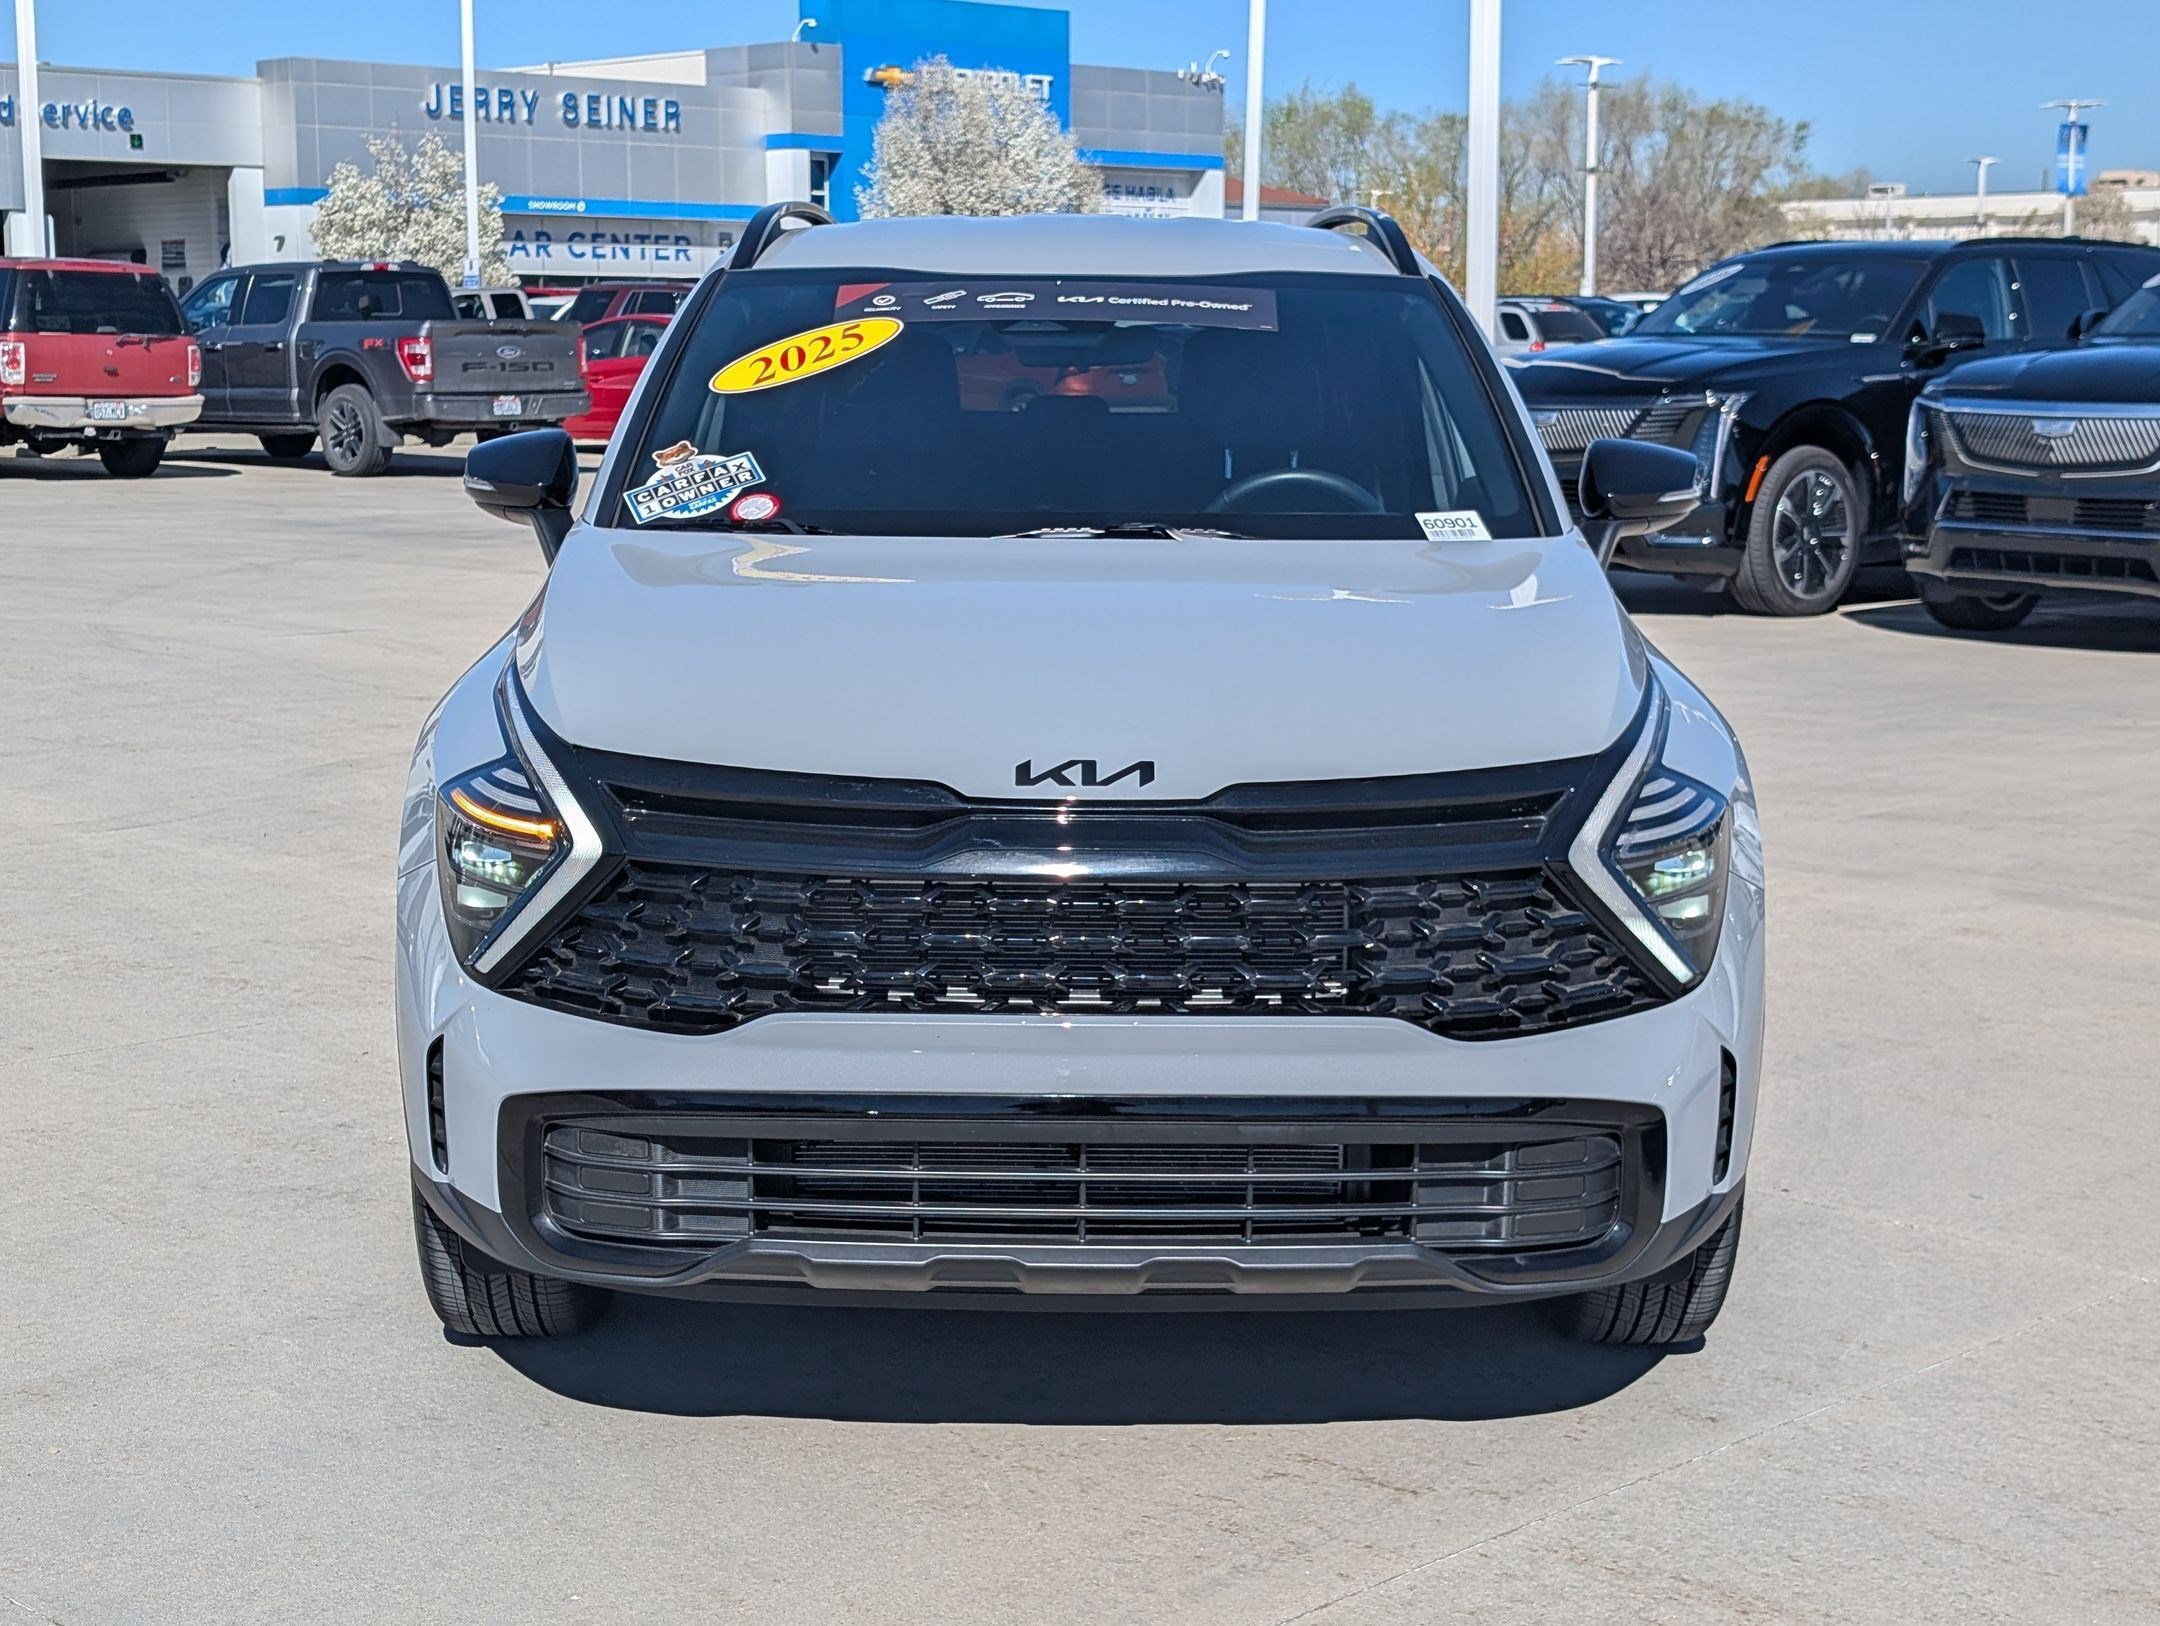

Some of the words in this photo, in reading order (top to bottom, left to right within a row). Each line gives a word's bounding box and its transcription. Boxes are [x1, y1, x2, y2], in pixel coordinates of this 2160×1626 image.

[41, 99, 134, 131] ervice
[426, 83, 539, 124] JERRY
[562, 92, 682, 133] SEINER
[527, 200, 577, 211] SHOWROOM
[273, 235, 286, 252] 7
[509, 229, 553, 258] AR
[567, 231, 692, 262] CENTER
[1108, 297, 1169, 307] Certified
[462, 361, 554, 373] F-150
[749, 323, 865, 386] 2025
[675, 462, 694, 472] CAR
[637, 461, 746, 503] CARFAX
[644, 504, 656, 515] 1
[661, 472, 753, 507] OWNER
[1422, 517, 1478, 529] 60901
[1015, 759, 1155, 788] KIA
